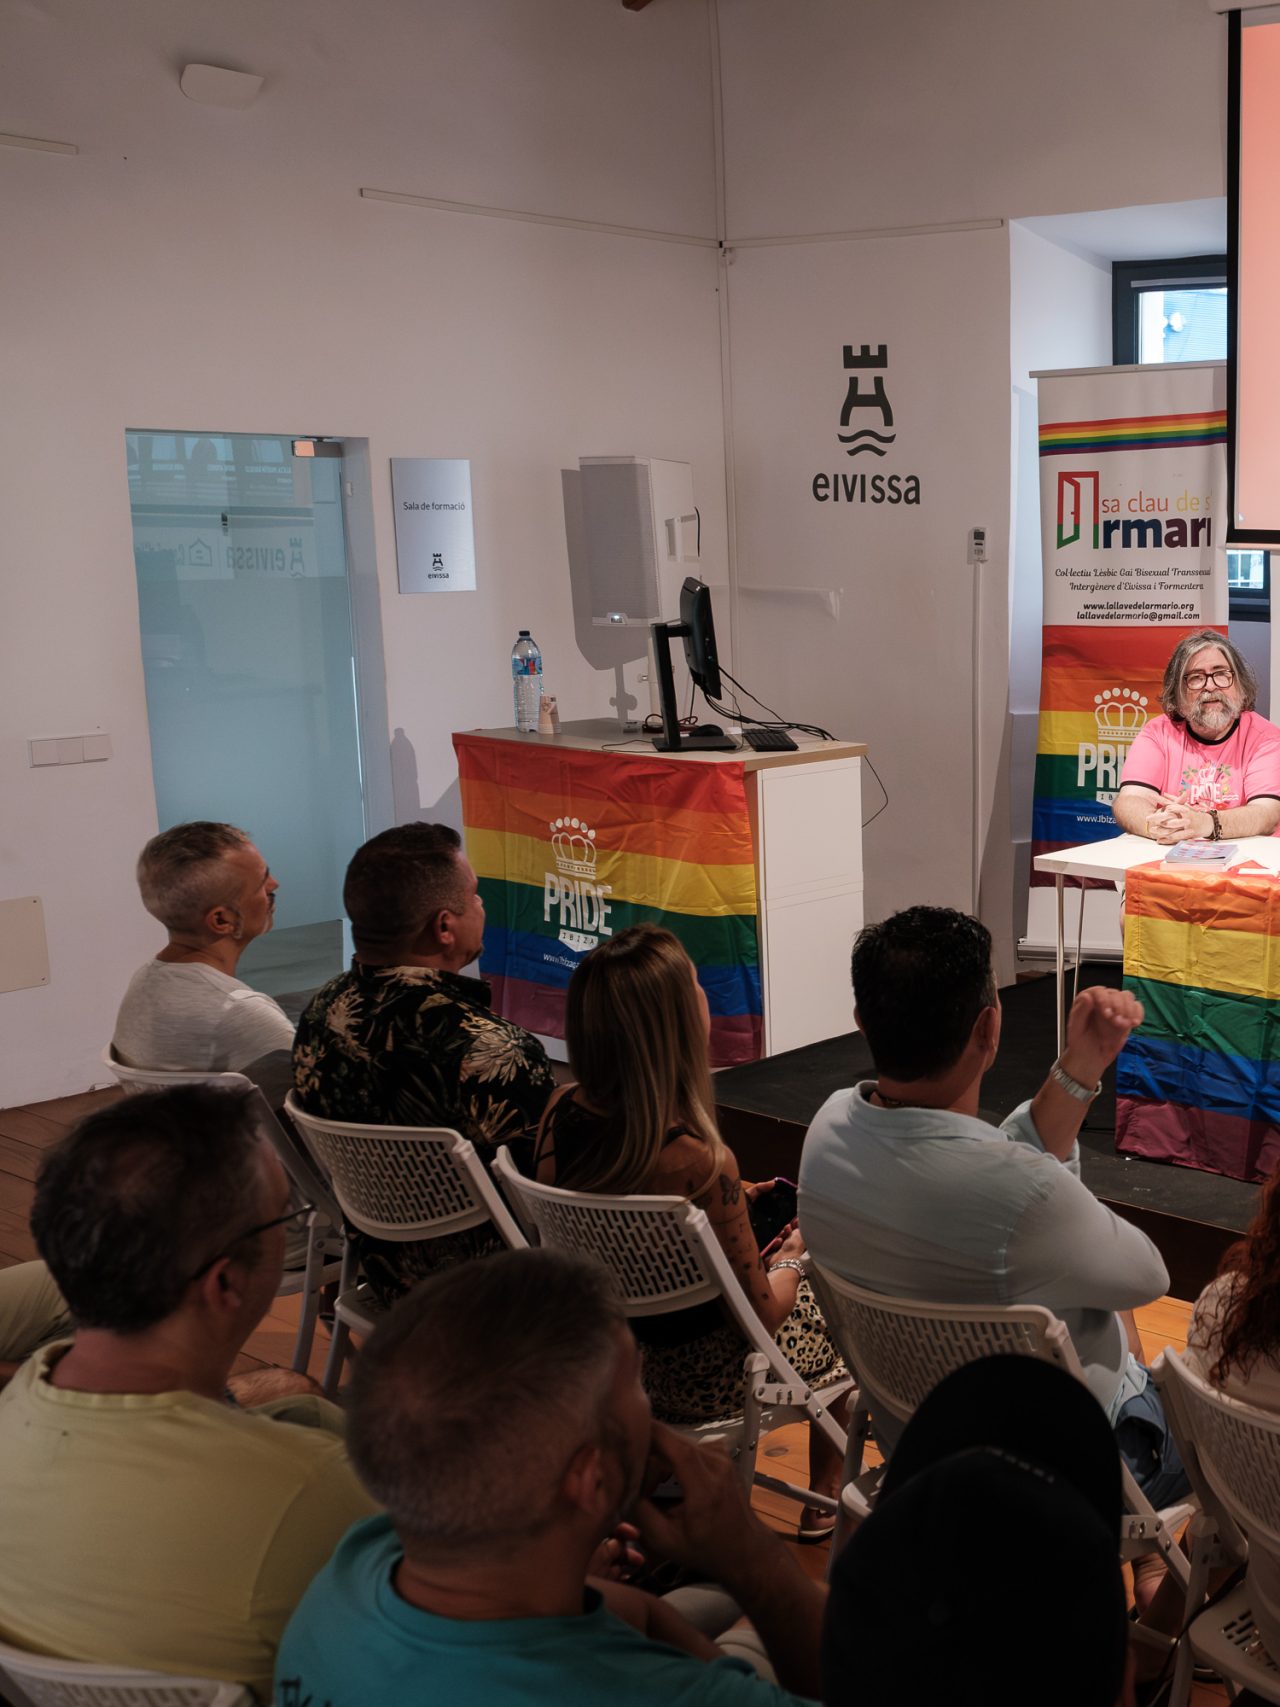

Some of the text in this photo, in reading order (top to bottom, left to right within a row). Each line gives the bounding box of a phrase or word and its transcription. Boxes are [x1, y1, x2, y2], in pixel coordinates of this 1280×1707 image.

[812, 472, 921, 505] eivissa
[403, 501, 466, 511] Sala de formació
[1102, 498, 1120, 513] sa
[1128, 490, 1168, 513] clau
[1176, 488, 1200, 513] de
[1093, 567, 1118, 577] Lèsbic
[1119, 567, 1133, 577] Gai
[1135, 567, 1170, 577] Bisexual
[1069, 581, 1115, 593] Intergènere
[1158, 581, 1204, 590] Formentera
[1083, 601, 1194, 611] www.lallavedelarmario.org
[1076, 611, 1200, 621] lallavedelarmario@gmail.com
[1077, 742, 1129, 789] PRI
[544, 871, 613, 936] PRIDE
[562, 932, 594, 944] IBIZA
